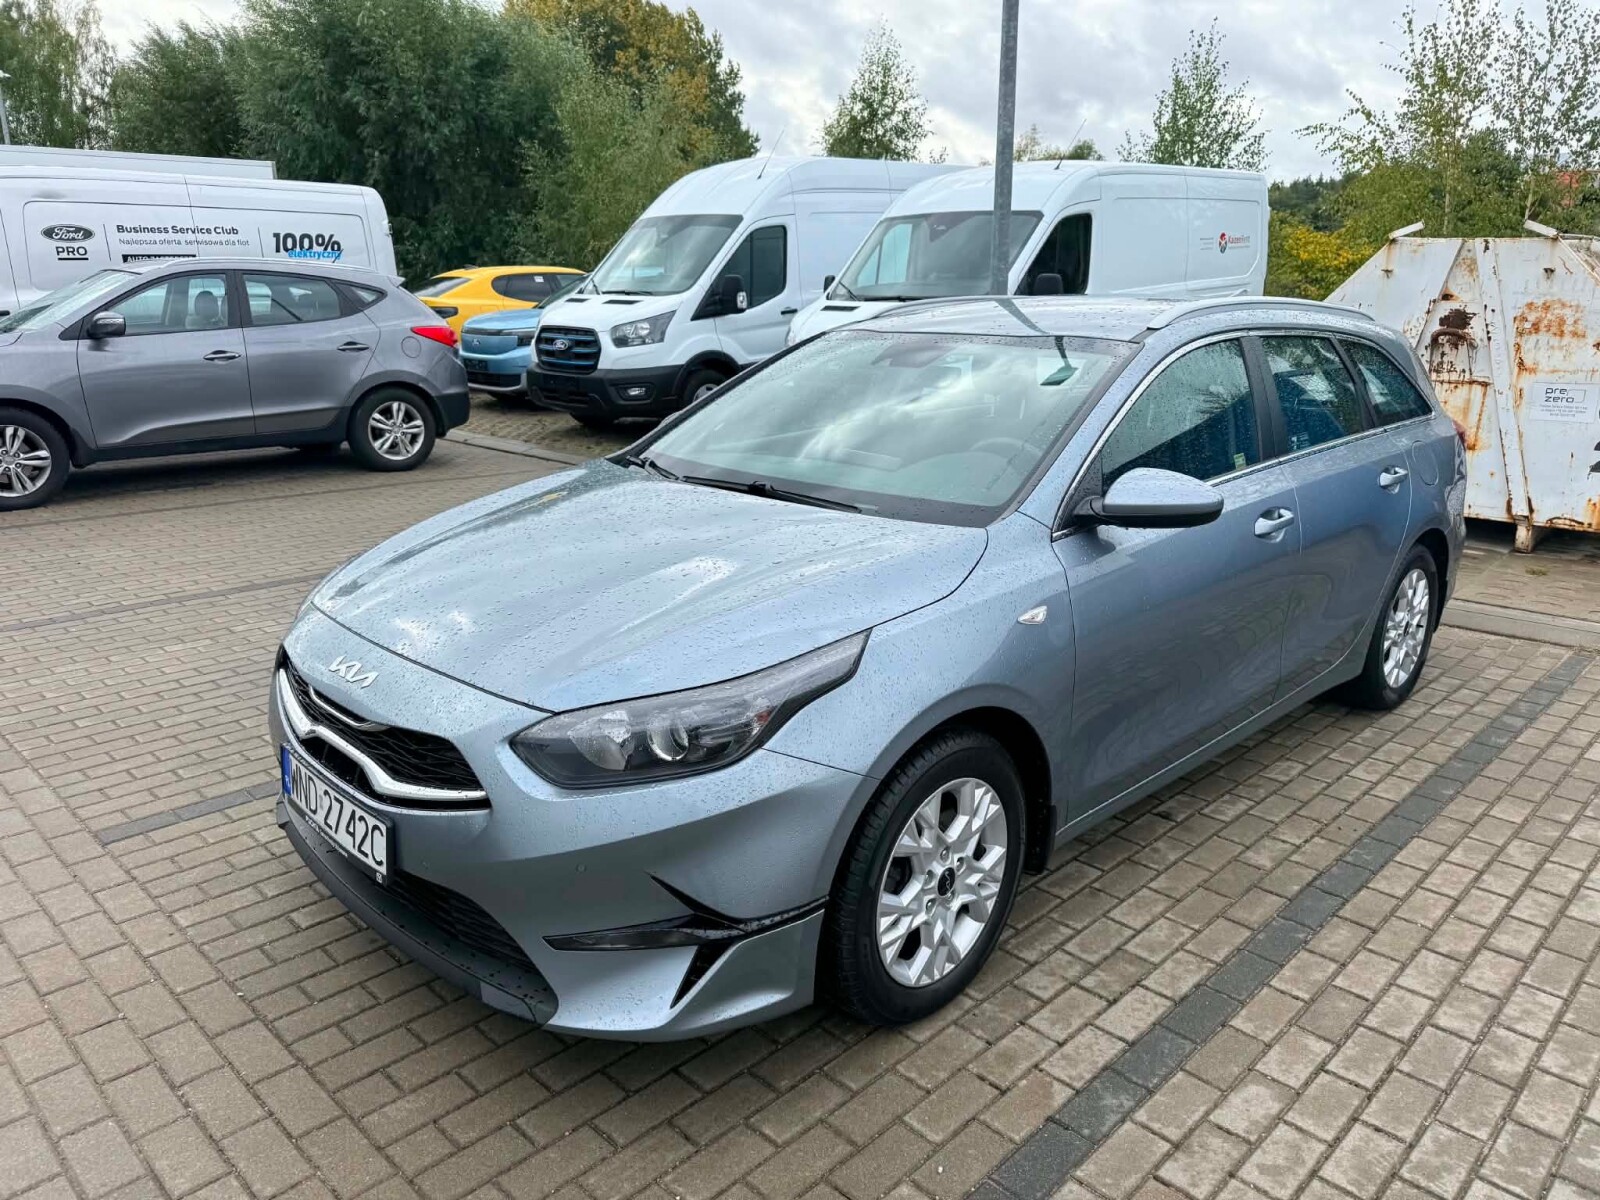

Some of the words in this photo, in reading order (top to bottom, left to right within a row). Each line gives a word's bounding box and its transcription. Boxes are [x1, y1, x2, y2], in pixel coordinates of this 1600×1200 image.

[51, 226, 85, 240] Ford
[116, 224, 170, 234] Business
[171, 225, 212, 235] Service
[213, 226, 239, 235] Club
[119, 238, 158, 247] Najlepsza
[272, 232, 342, 253] 100%
[55, 246, 88, 256] PRO
[288, 250, 342, 259] elektryczny
[291, 763, 318, 815] WND
[323, 789, 384, 867] 2742C
